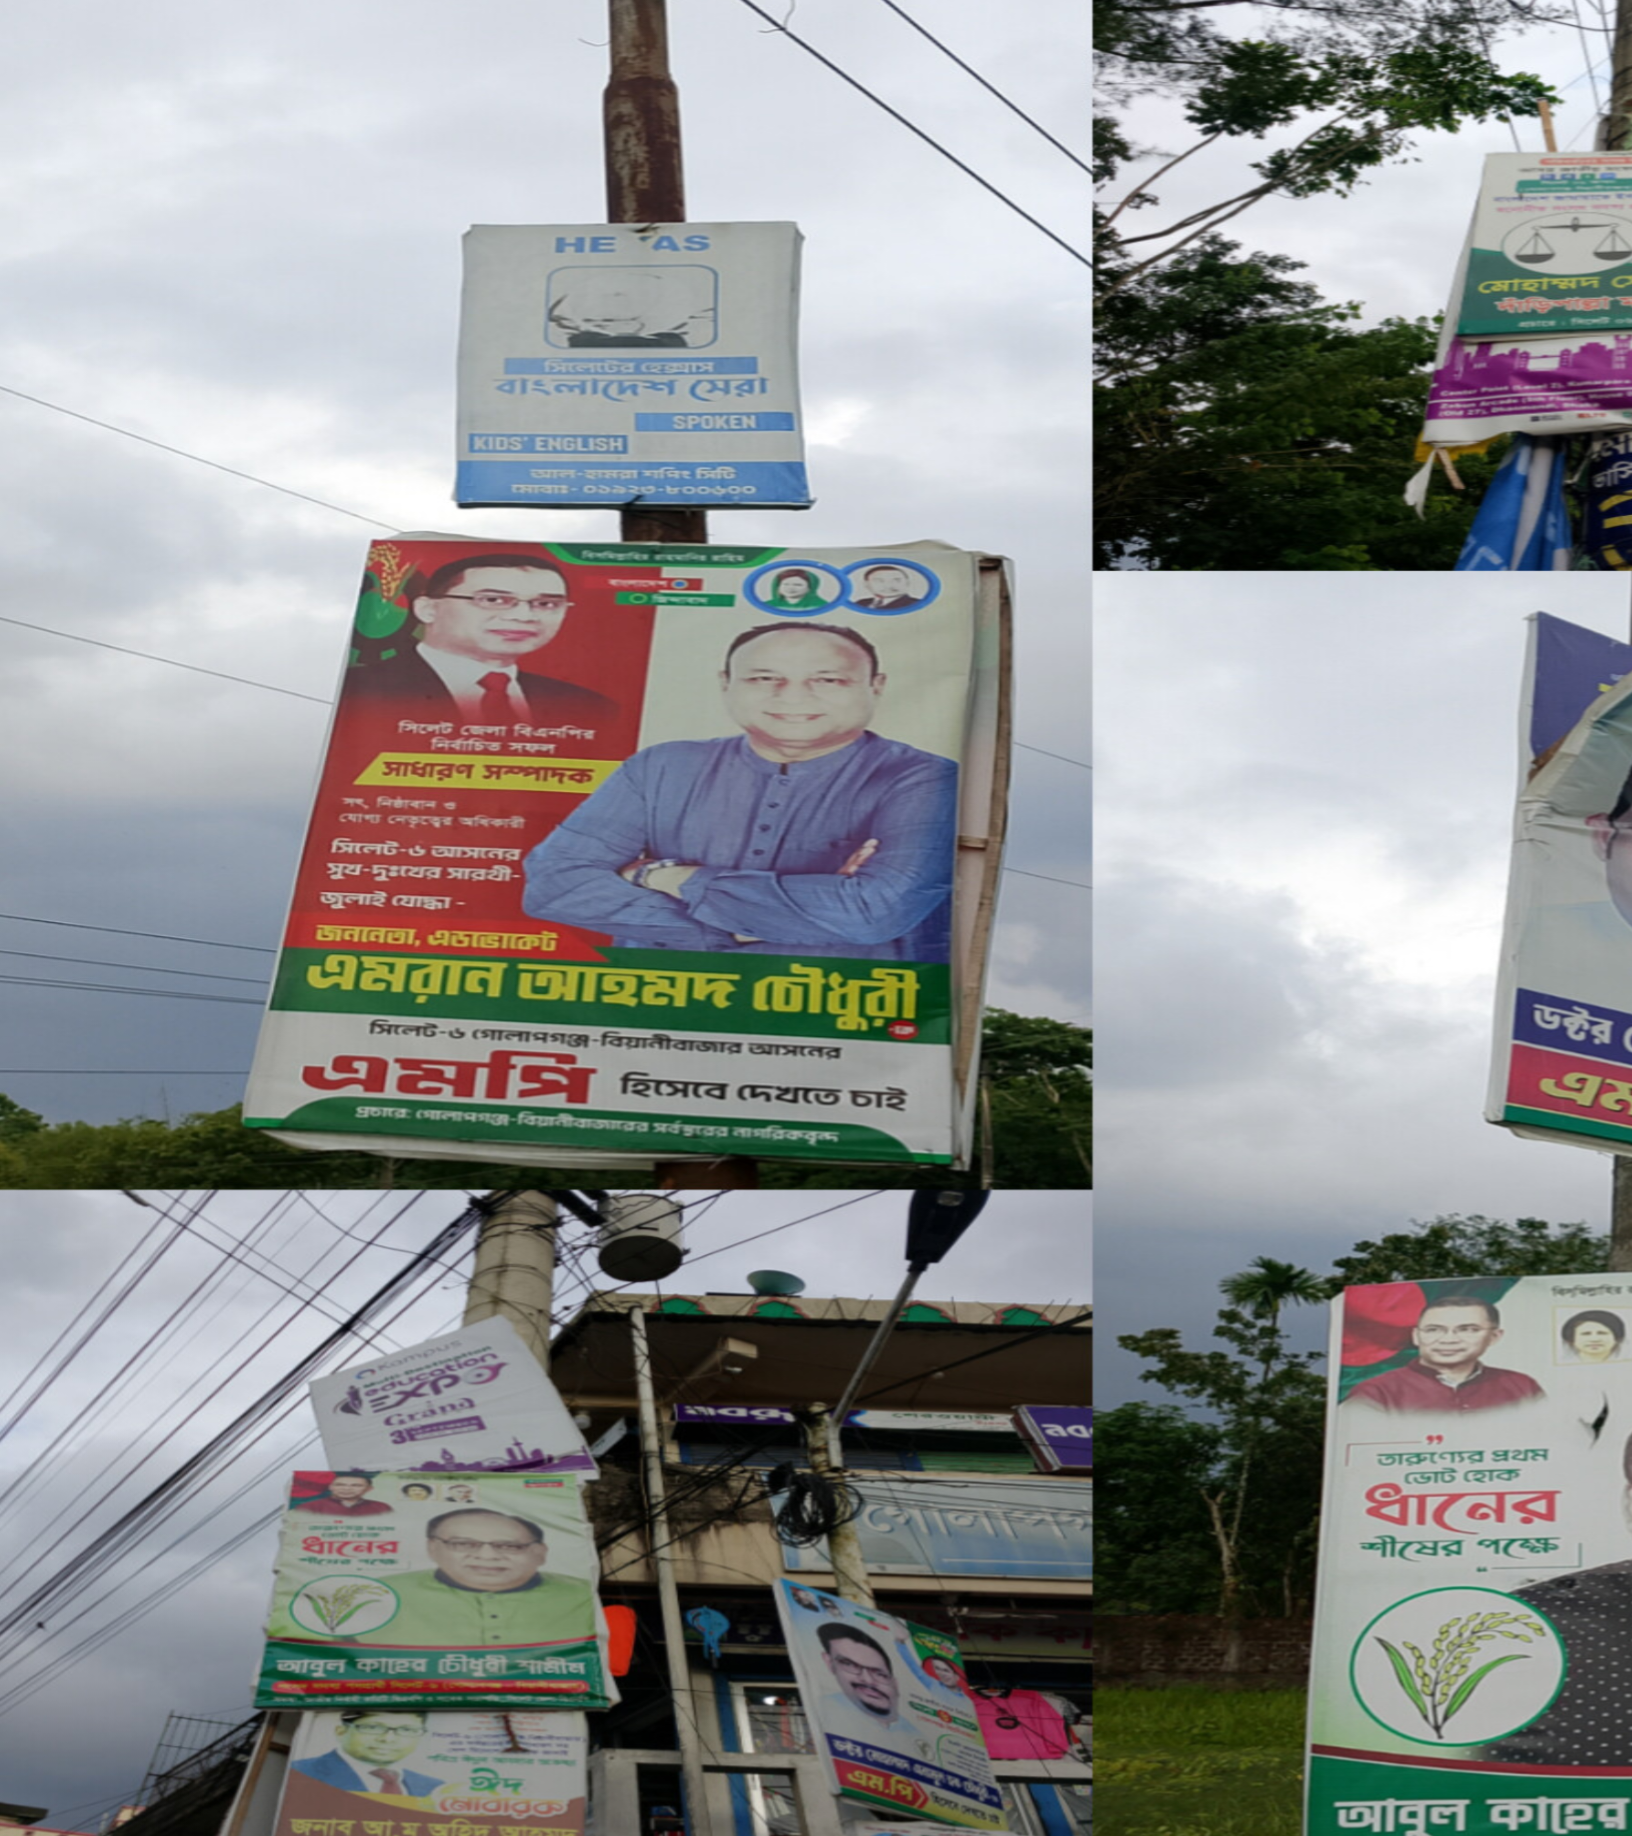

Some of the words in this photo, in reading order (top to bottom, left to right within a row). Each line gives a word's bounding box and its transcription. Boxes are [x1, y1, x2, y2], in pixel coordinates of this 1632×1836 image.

[1477, 276, 1599, 294] মোহাম্মদ
[494, 377, 679, 401] বাংলাদেশ
[688, 376, 770, 401] সেরা
[672, 415, 757, 430] SPOKEN
[535, 437, 623, 452] ENGLISH
[398, 720, 454, 736] সিলেট
[461, 724, 506, 737] জেলা
[514, 724, 595, 740] বিএনপির
[382, 760, 475, 781] সাধারণ
[483, 765, 595, 784] সম্পাদক
[331, 838, 426, 857] সিলেট-৬
[432, 846, 522, 861] আসনের
[320, 890, 387, 910] জুলাই
[427, 929, 558, 951] এডভোকেট
[306, 953, 507, 1004] এমরান
[517, 962, 740, 1009] আহমদ
[752, 963, 921, 1031] চৌধুরী
[1533, 1004, 1613, 1045] ডক্টর
[369, 1019, 465, 1039] সিলেট-৬
[748, 1042, 842, 1060] আসনের
[302, 1050, 597, 1104] এমপি
[620, 1072, 728, 1100] হিসেবে
[737, 1082, 841, 1107] দেখতে
[848, 1086, 908, 1111] চাই
[364, 1353, 498, 1397] education
[1377, 1450, 1485, 1466] তারুণ্যের
[1491, 1448, 1549, 1463] প্রথম
[1404, 1467, 1457, 1484] ভোট
[1463, 1468, 1522, 1483] হোক
[1364, 1482, 1563, 1535] ধানের
[302, 1536, 400, 1558] ধানের
[1359, 1535, 1466, 1562] শীষের
[1476, 1537, 1562, 1559] পক্ষে
[277, 1658, 348, 1679] আবুল
[356, 1656, 430, 1675] কাহের
[438, 1653, 507, 1679] চৌধুরী
[518, 1656, 586, 1675] শামীম
[469, 1767, 527, 1796] ঈদ
[846, 1766, 917, 1802] এম.পি
[439, 1797, 567, 1815] মোবারক
[1334, 1798, 1471, 1836] আবুল
[1485, 1796, 1631, 1834] কাহের
[290, 1817, 356, 1836] জনাব
